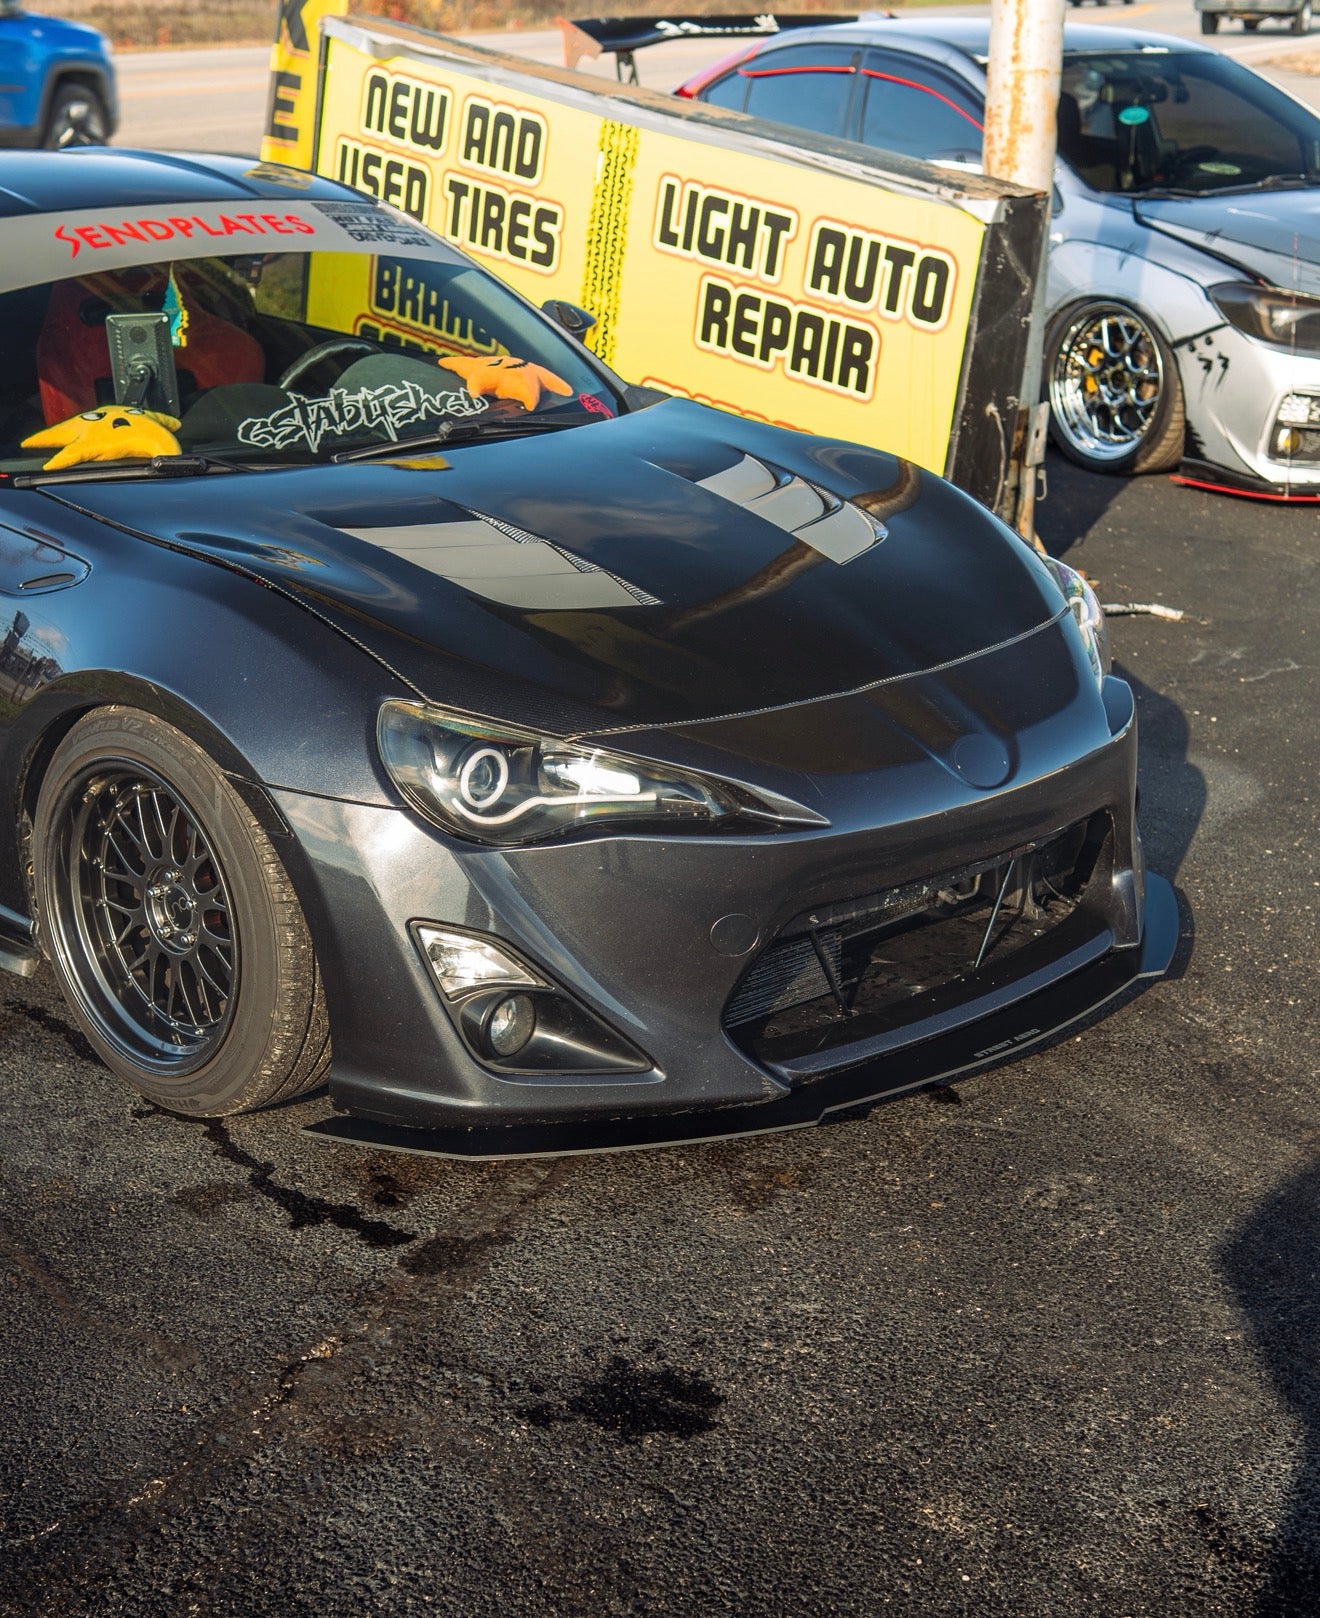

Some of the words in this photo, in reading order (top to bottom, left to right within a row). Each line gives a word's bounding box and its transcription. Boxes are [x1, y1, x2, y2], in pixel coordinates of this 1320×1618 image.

[365, 74, 448, 151] NEW
[463, 103, 543, 181] AND
[54, 214, 316, 260] SENDPLATES
[339, 144, 427, 223] USED
[447, 178, 560, 268] TIRES
[659, 183, 792, 277] LIGHT
[809, 226, 950, 324] AUTO
[700, 282, 874, 394] REPAIR
